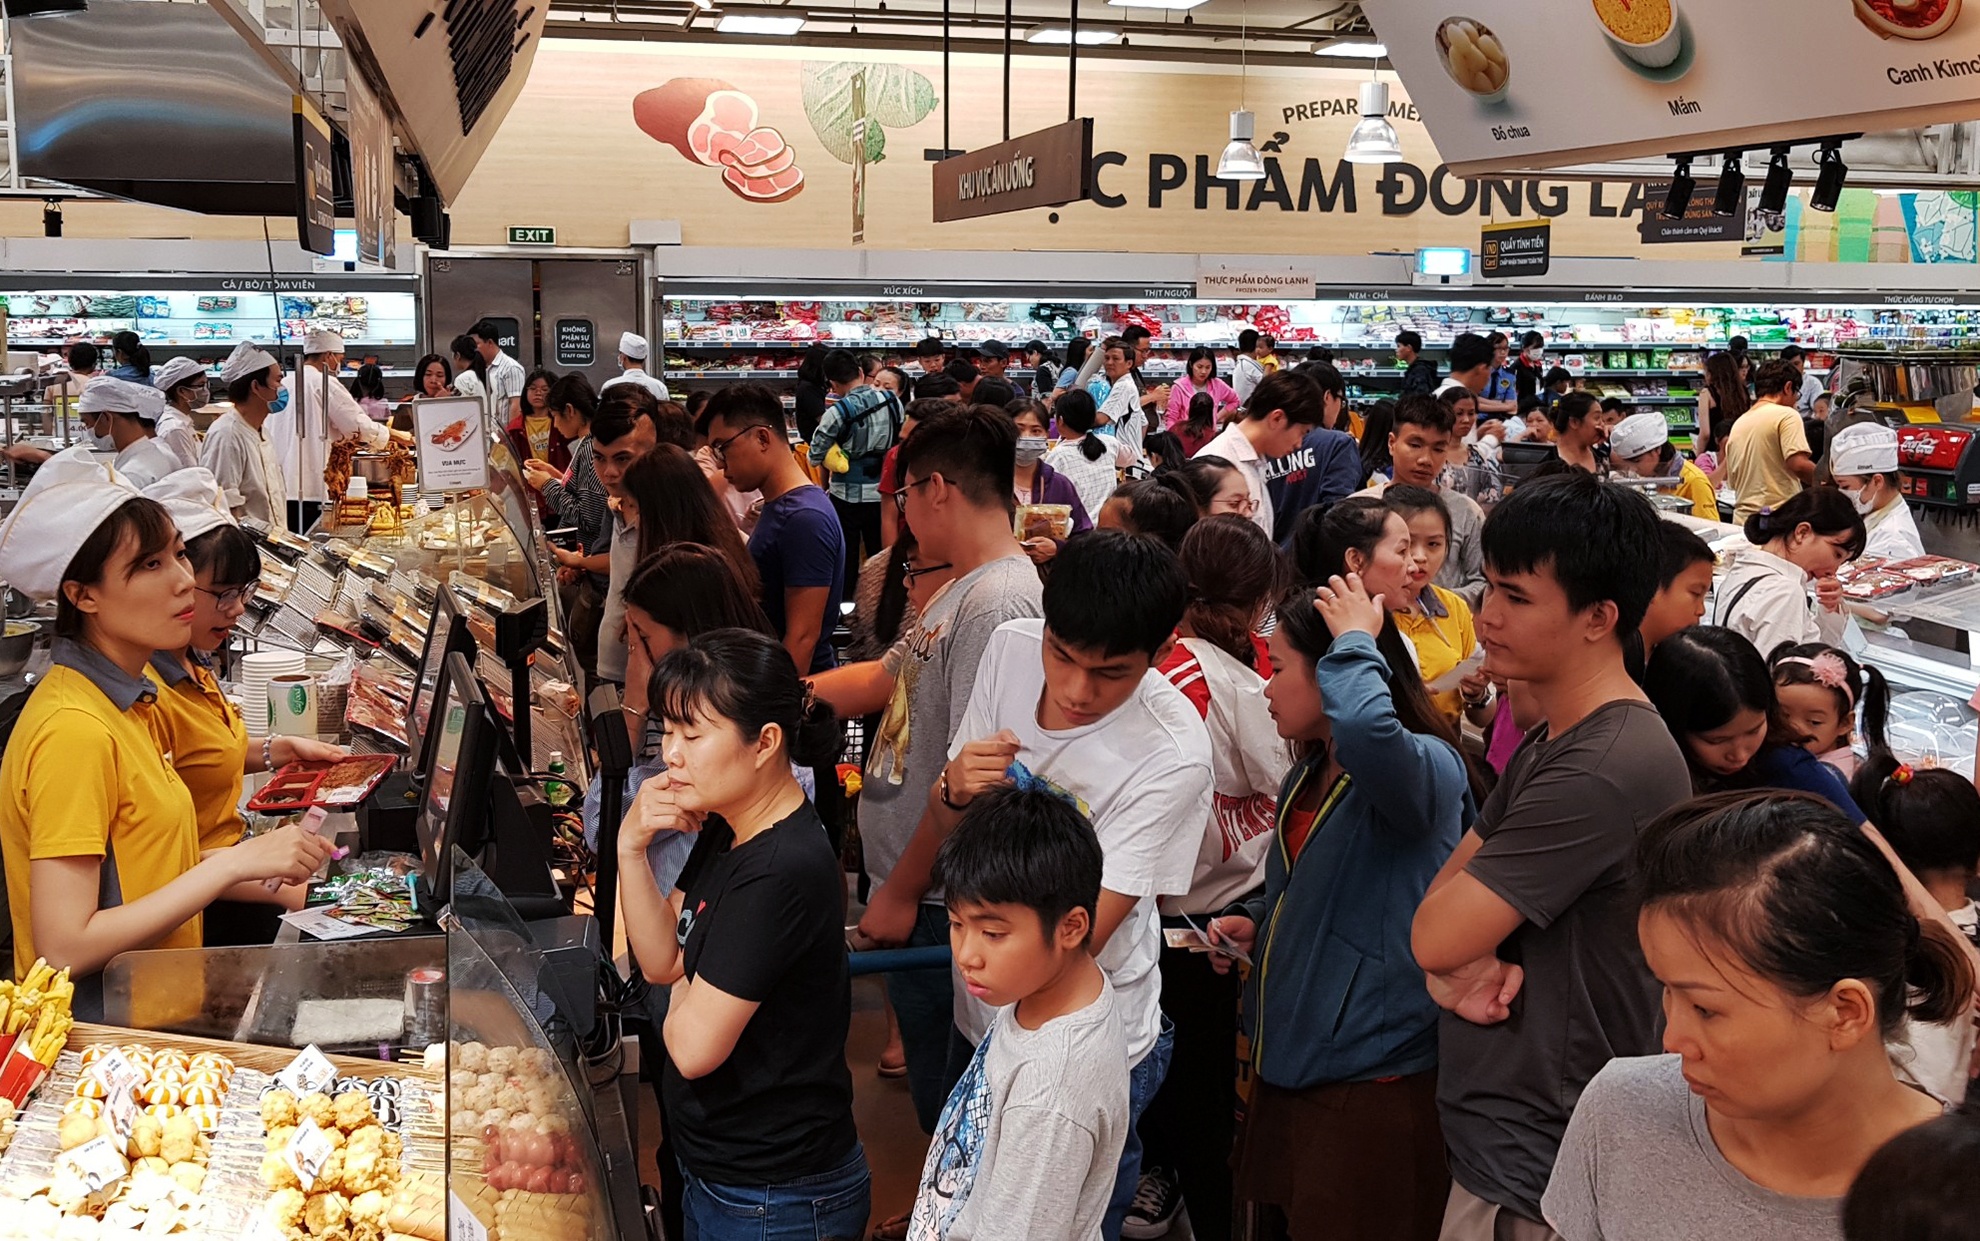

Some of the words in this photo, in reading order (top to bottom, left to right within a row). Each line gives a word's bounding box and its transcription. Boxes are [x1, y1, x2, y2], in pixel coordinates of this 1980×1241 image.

[1886, 63, 1934, 85] Canh
[1282, 98, 1358, 124] PREPAR
[1667, 96, 1702, 116] Mắm
[1507, 125, 1531, 139] chua
[959, 172, 975, 200] KHU
[976, 167, 992, 202] VỰC
[1005, 150, 1034, 191] UỐNG
[1148, 131, 1357, 213] PHẨM
[515, 229, 549, 241] EXIT
[222, 279, 236, 289] CÁ
[291, 279, 315, 289] VIÊN
[1204, 276, 1228, 286] THỰC
[1230, 273, 1255, 285] PHẨM
[1257, 275, 1283, 284] ĐÔNG
[1285, 276, 1309, 286] LẠNH
[883, 285, 901, 295] XÚC
[902, 285, 923, 295] XÍCH
[1144, 289, 1163, 298] THỊT
[1164, 288, 1191, 298] NGUỘI
[1372, 290, 1389, 299] CHẢ
[1585, 292, 1606, 301] BÁNH
[562, 325, 587, 333] KHÔNG
[561, 333, 580, 342] PHẬN
[580, 334, 590, 342] SỰ
[560, 341, 575, 349] CẤM
[576, 341, 591, 349] VÀO
